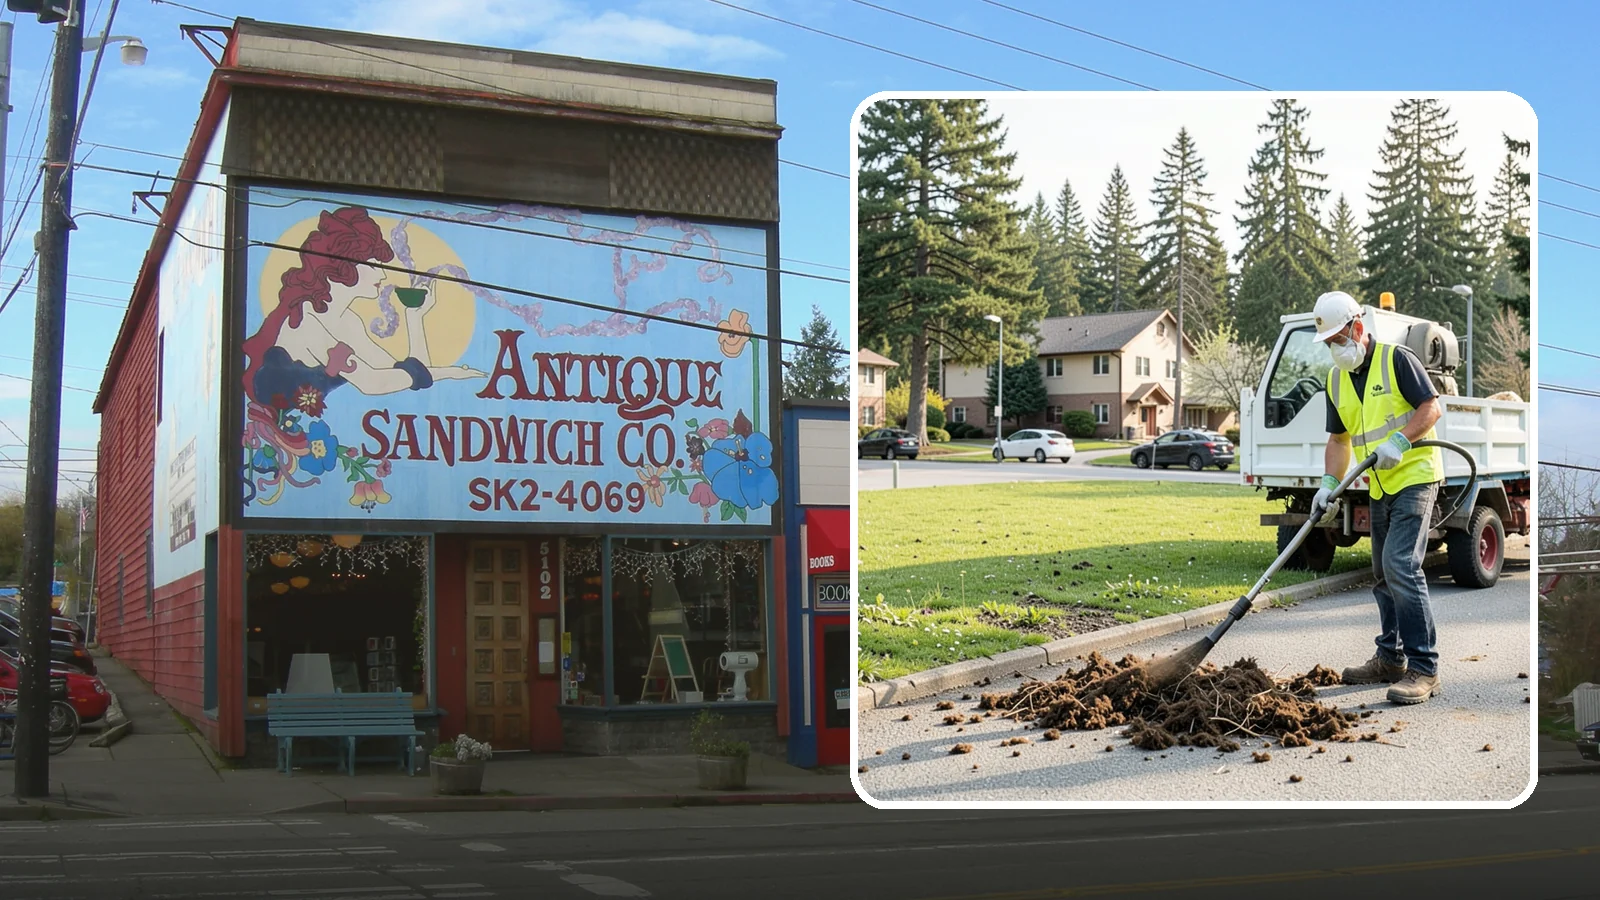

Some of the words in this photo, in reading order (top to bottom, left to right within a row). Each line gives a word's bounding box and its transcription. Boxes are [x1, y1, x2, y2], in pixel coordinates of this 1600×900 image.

[476, 329, 723, 421] ANTIQUE
[361, 409, 604, 467] SANDWICH
[617, 421, 685, 469] CO.
[468, 477, 646, 513] SK2-4069
[540, 541, 551, 600] 5102
[809, 555, 835, 568] BOOKS
